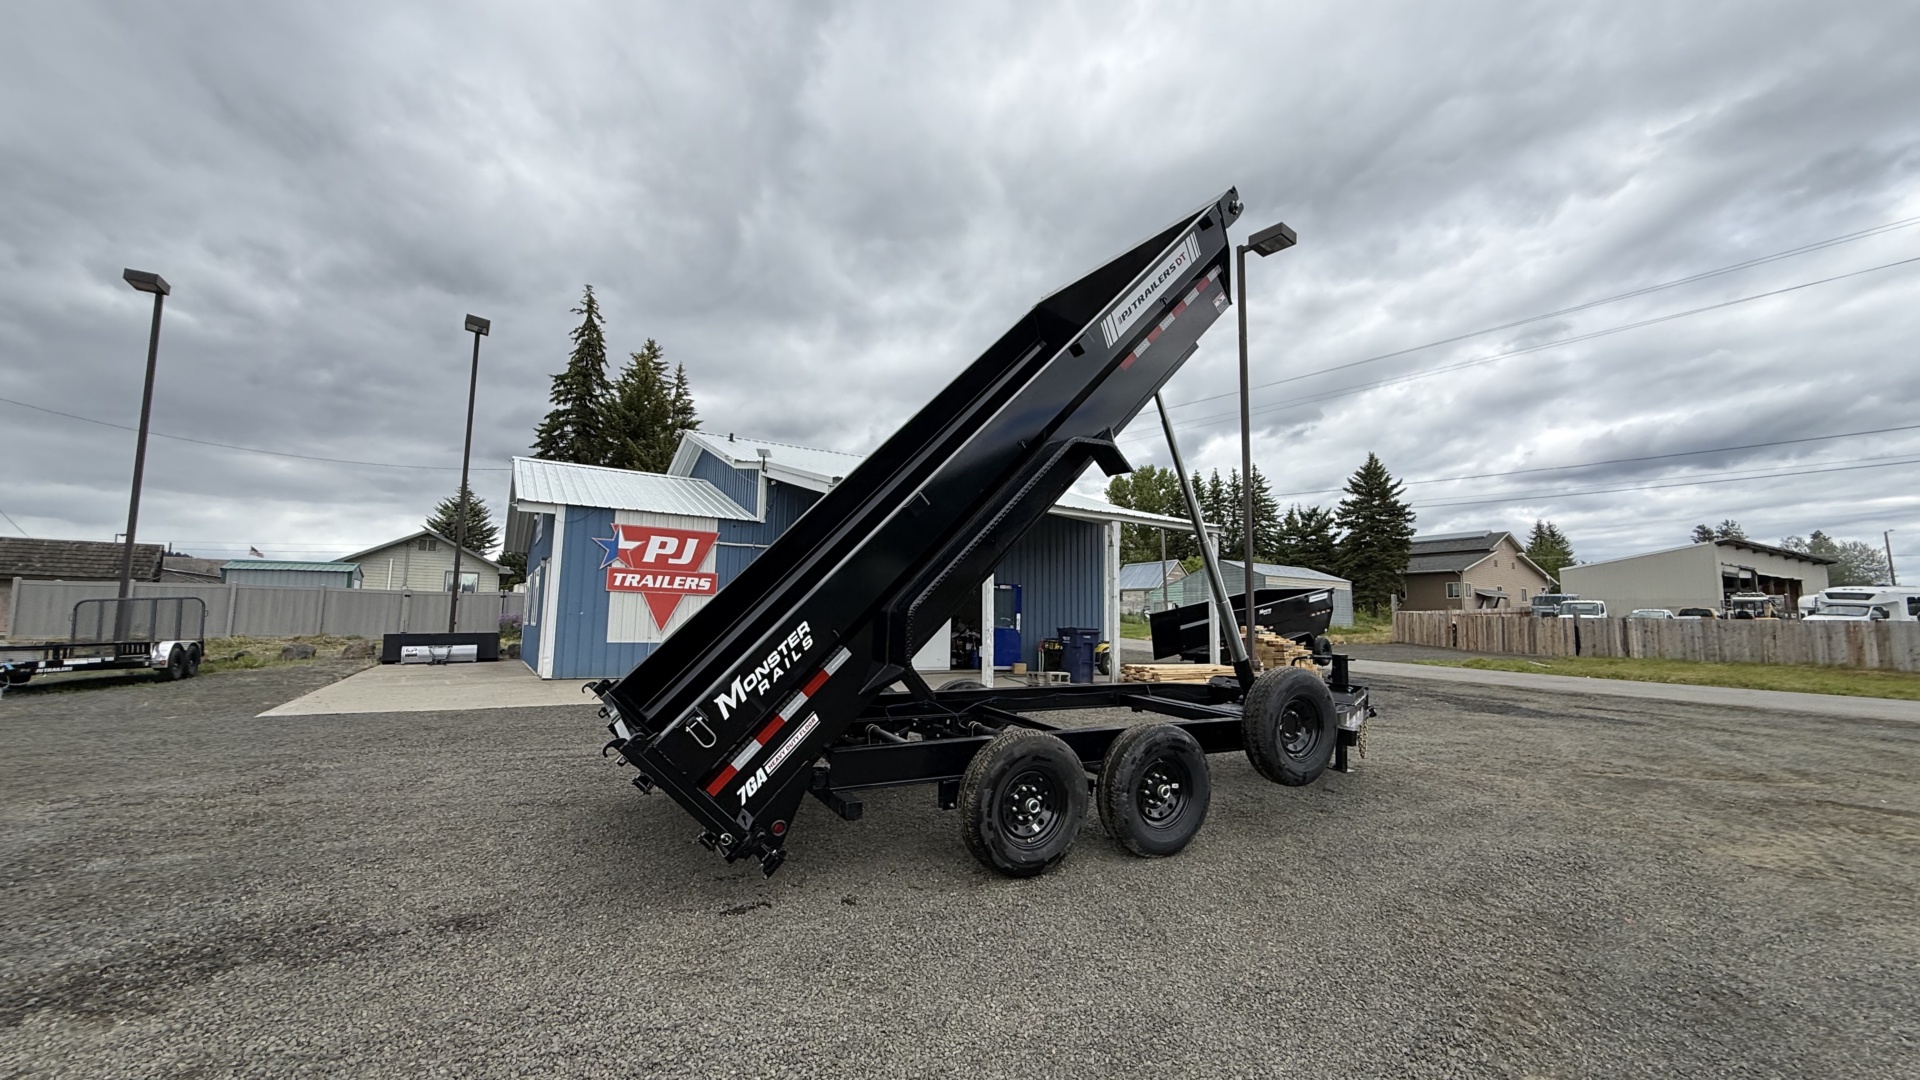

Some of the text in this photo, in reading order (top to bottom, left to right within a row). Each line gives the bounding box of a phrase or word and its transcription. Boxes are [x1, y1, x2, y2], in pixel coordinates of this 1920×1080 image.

[1131, 263, 1177, 309] TRAILERS
[1175, 252, 1187, 267] DT
[642, 535, 700, 565] PJ
[613, 572, 712, 591] TRAILERS
[757, 635, 814, 696] RAILS
[736, 717, 816, 806] 7GA HEAVY DUTY FLOOR
